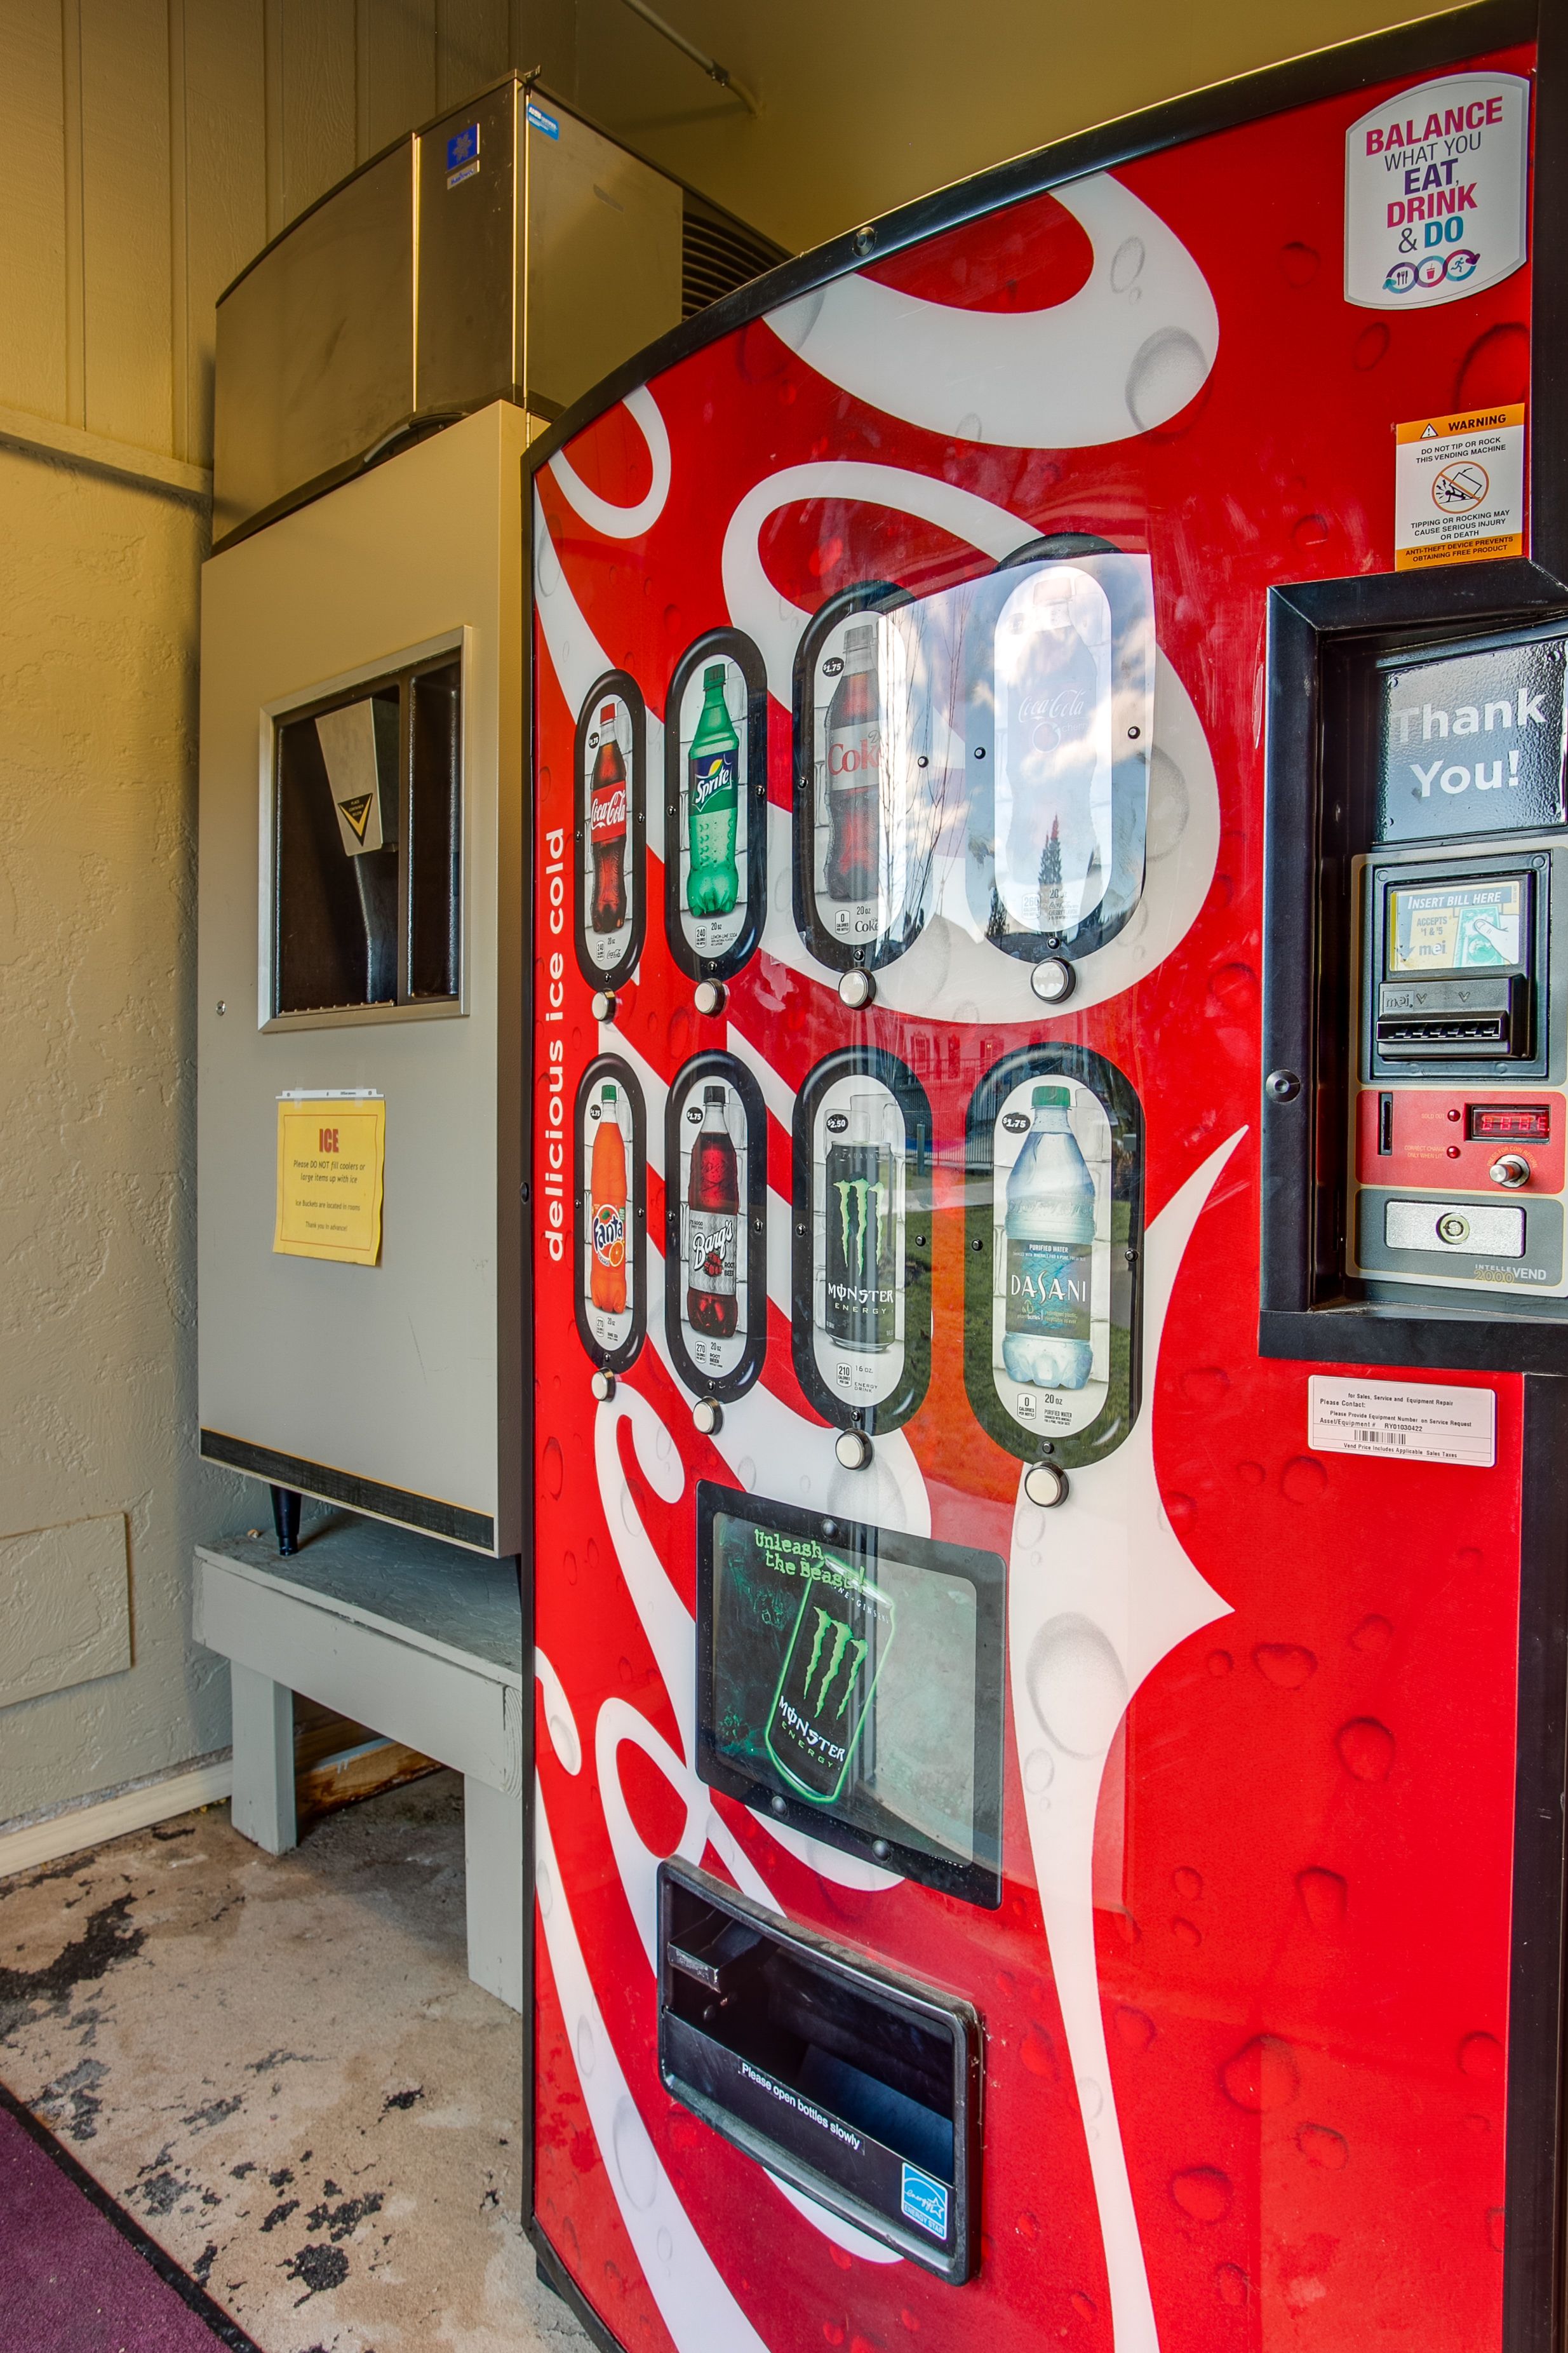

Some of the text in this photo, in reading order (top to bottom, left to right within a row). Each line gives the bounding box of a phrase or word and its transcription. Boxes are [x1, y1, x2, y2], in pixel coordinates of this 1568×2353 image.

[1366, 96, 1503, 156] BALANCE
[1384, 131, 1481, 172] WHAT YOU
[1404, 158, 1459, 196] EAT,
[1387, 182, 1478, 228] DRINK
[1398, 215, 1464, 253] & DO
[1449, 414, 1506, 431] WARNING
[1435, 445, 1450, 453] NOT
[1478, 437, 1501, 445] ROCK
[1435, 450, 1468, 461] VENDING
[1471, 444, 1506, 455] MACHINE
[1411, 519, 1440, 529] TIPPING
[1456, 512, 1491, 522] ROCKING
[1414, 518, 1506, 536] CAUSE SERIOUS INJURY
[1454, 530, 1479, 539] DEATH
[1405, 536, 1513, 556] ANTI-THEFT DEVICE PREVENTS
[1412, 551, 1451, 562] OBTAINING
[1473, 544, 1508, 554] PRODUCT
[823, 663, 841, 673] $1.75
[1018, 689, 1087, 723] Coca-Cola
[1391, 687, 1548, 744] Thank
[1409, 750, 1519, 798] You!
[695, 765, 729, 804] Sprite
[591, 790, 626, 830] Coca-Cola
[1407, 896, 1444, 909] INSERT
[1447, 894, 1470, 906] BILL
[1473, 891, 1501, 903] HERE
[857, 906, 864, 915] 20
[1417, 917, 1447, 926] ACCEPTS
[697, 929, 706, 937] 240
[1430, 927, 1435, 936] &
[545, 828, 564, 1262] delicious ice cold
[590, 1109, 601, 1117] $1.75
[687, 1112, 702, 1121] $1.75
[827, 1119, 846, 1128] $2.50
[1003, 1117, 1026, 1128] $1.75
[319, 1128, 339, 1153] ICE
[293, 1160, 309, 1168] Please
[310, 1161, 317, 1169] DO
[319, 1161, 330, 1169] NOT
[1487, 1150, 1499, 1167] PRESS
[1523, 1149, 1538, 1168] RETURN
[300, 1173, 313, 1182] large
[315, 1173, 328, 1182] items
[337, 1175, 349, 1183] with
[593, 1213, 624, 1254] Fanta
[692, 1220, 734, 1271] Barq's
[1029, 1244, 1052, 1252] PURIFIED
[1474, 1269, 1515, 1283] 2000
[1011, 1271, 1085, 1305] DASANI
[834, 1302, 887, 1314] ENERGY
[697, 1344, 705, 1352] 270
[711, 1342, 716, 1350] 20
[839, 1366, 850, 1375] 210
[1024, 1397, 1029, 1406] 0
[1045, 1394, 1054, 1404] 20
[1320, 1417, 1423, 1432] Asset/Equipment RY01030422
[754, 1528, 824, 1560] Unleash
[765, 1550, 796, 1575] the
[800, 1557, 865, 1593] Beast!
[781, 1721, 833, 1767] ENERGY
[742, 2062, 861, 2150] Please open bottles slowly
[904, 2204, 943, 2235] ENERGY STAR
